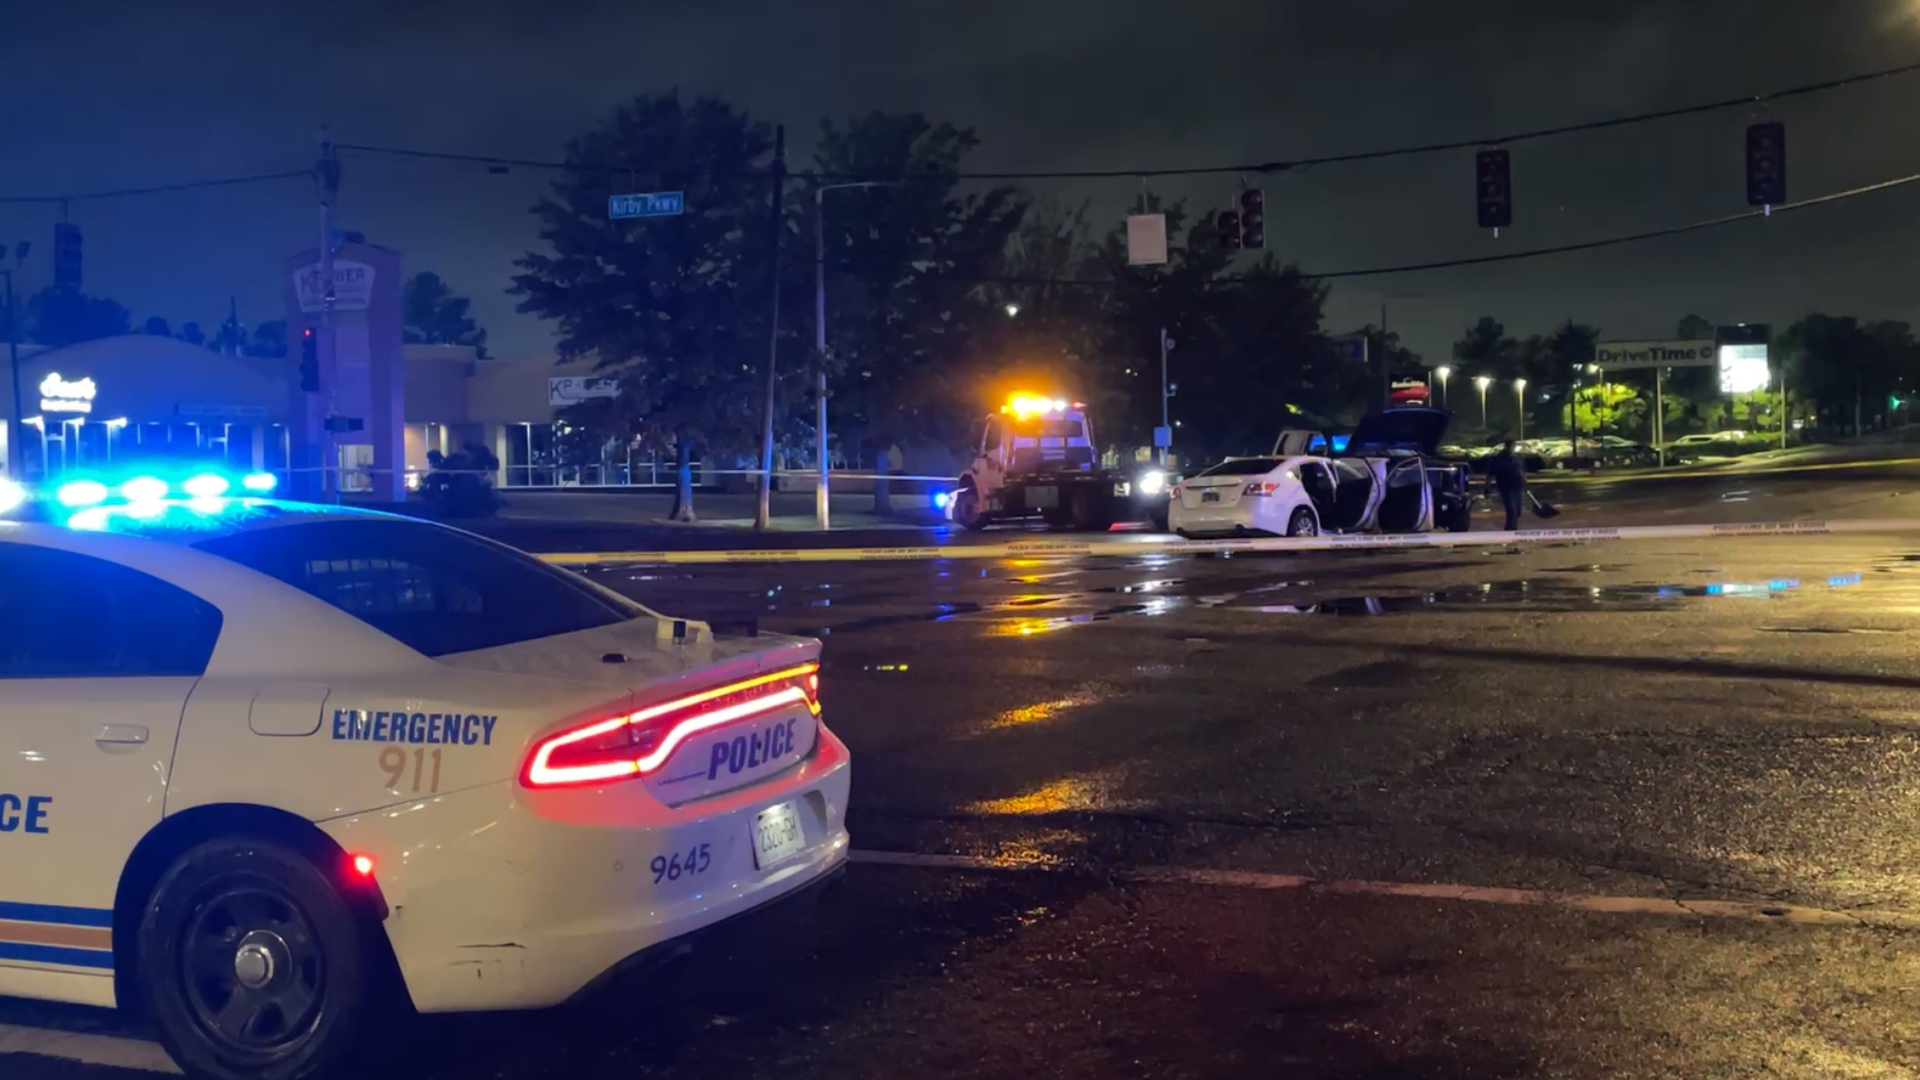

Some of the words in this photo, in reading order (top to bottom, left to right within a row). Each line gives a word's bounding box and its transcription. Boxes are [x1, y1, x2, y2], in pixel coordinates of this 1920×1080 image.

[612, 197, 642, 216] Kirby
[647, 195, 679, 212] Pkwy
[1598, 346, 1697, 362] DriveTime
[332, 710, 498, 745] EMERGENCY
[708, 718, 796, 780] POLICE
[379, 746, 442, 793] 911
[0, 793, 53, 833] CE
[650, 843, 710, 884] 9645
